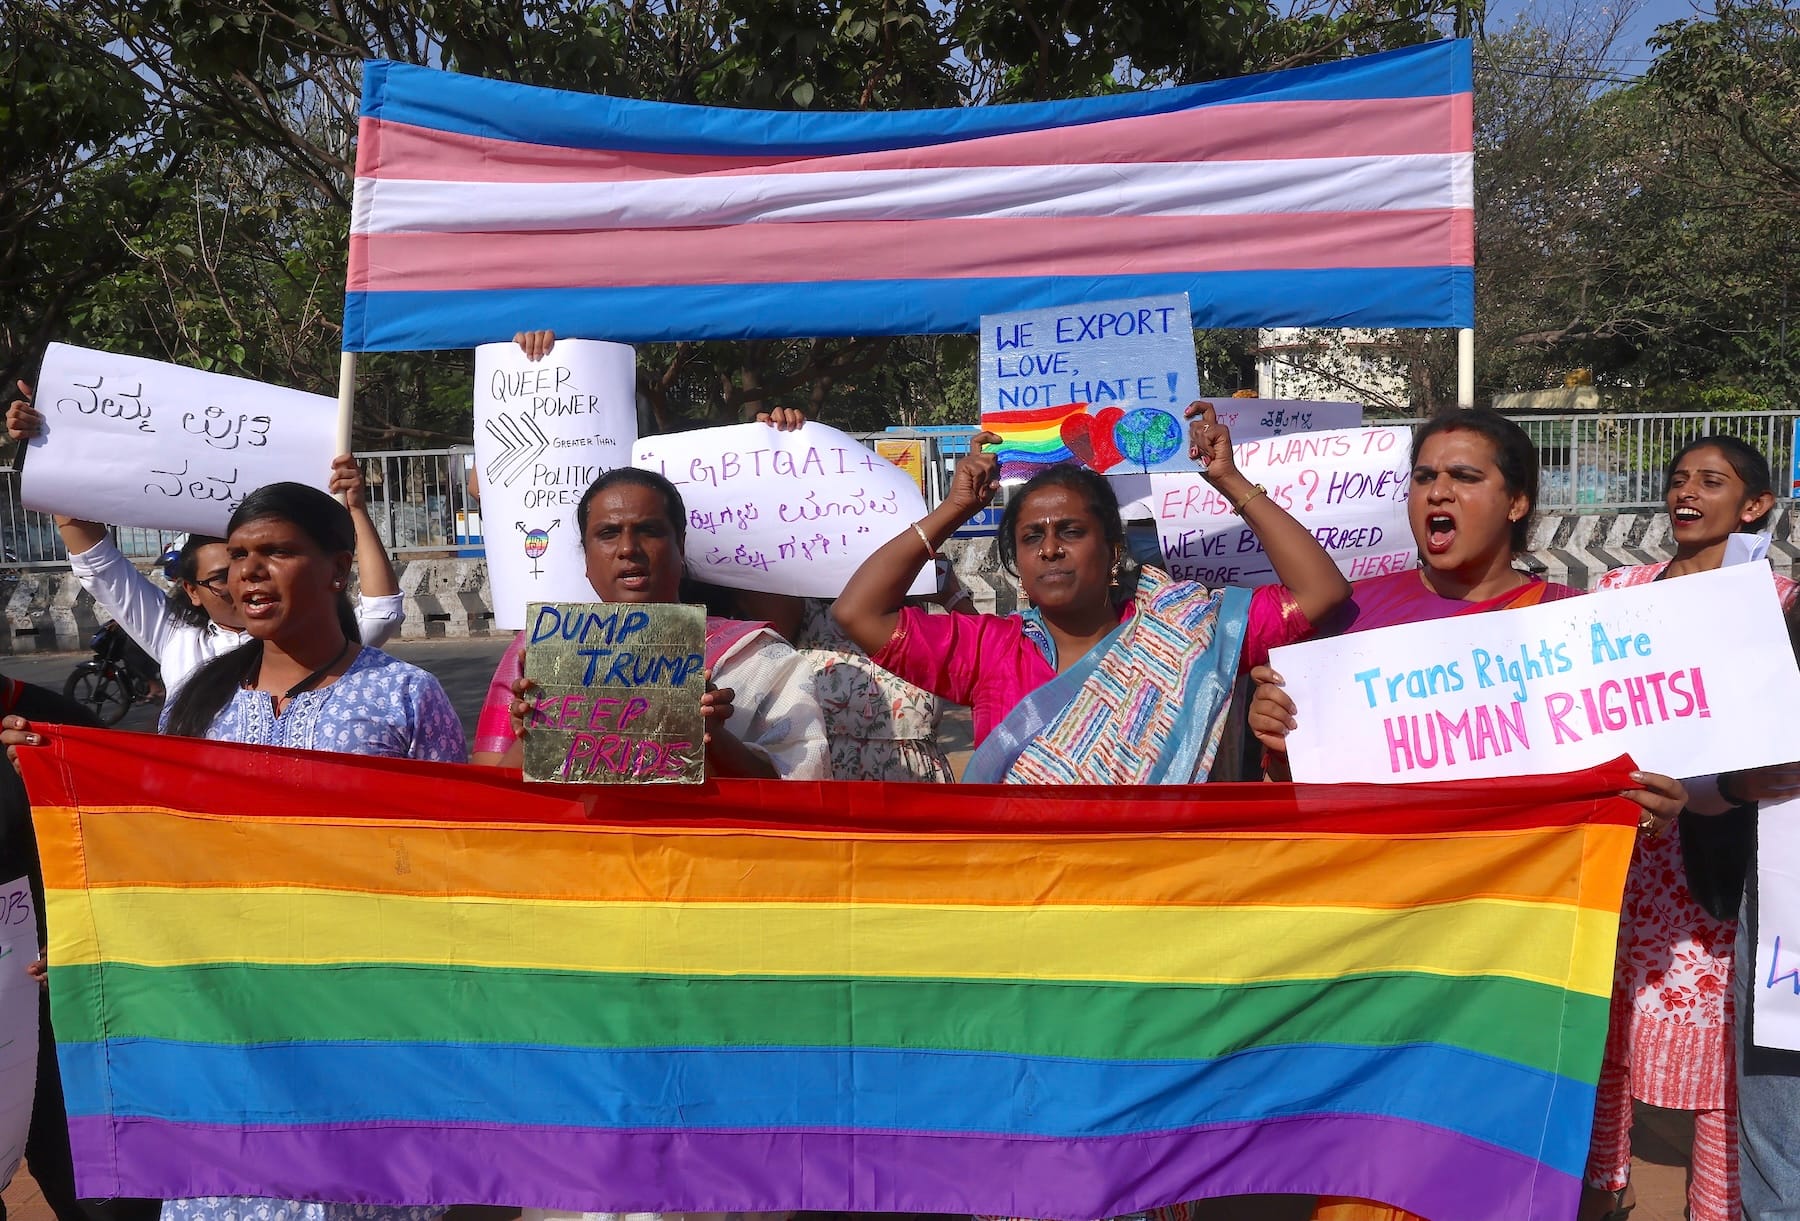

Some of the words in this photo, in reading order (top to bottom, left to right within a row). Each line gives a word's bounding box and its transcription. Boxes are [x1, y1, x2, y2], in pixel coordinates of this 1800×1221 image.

[996, 323, 1033, 351] WE
[1056, 307, 1175, 343] EXPORT
[998, 351, 1079, 378] LOVE,
[491, 366, 577, 403] QUEER
[999, 384, 1056, 410] NOT
[532, 395, 600, 420] POWER
[1267, 436, 1351, 466] WANTS
[1362, 430, 1395, 453] TO
[533, 464, 612, 487] POLITIC
[1162, 485, 1234, 519] ERAS
[1163, 529, 1227, 560] WE'VE
[1349, 552, 1410, 577] HERE!
[531, 606, 650, 645] DUMP
[577, 648, 703, 688] TRUMP
[1355, 661, 1464, 708] Trans
[1472, 638, 1573, 703] Rights
[1591, 622, 1652, 665] Are
[530, 691, 650, 731] KEEP
[1384, 701, 1530, 773] HUMAN
[1545, 667, 1711, 747] RIGHTS!
[562, 733, 692, 777] PRIDE
